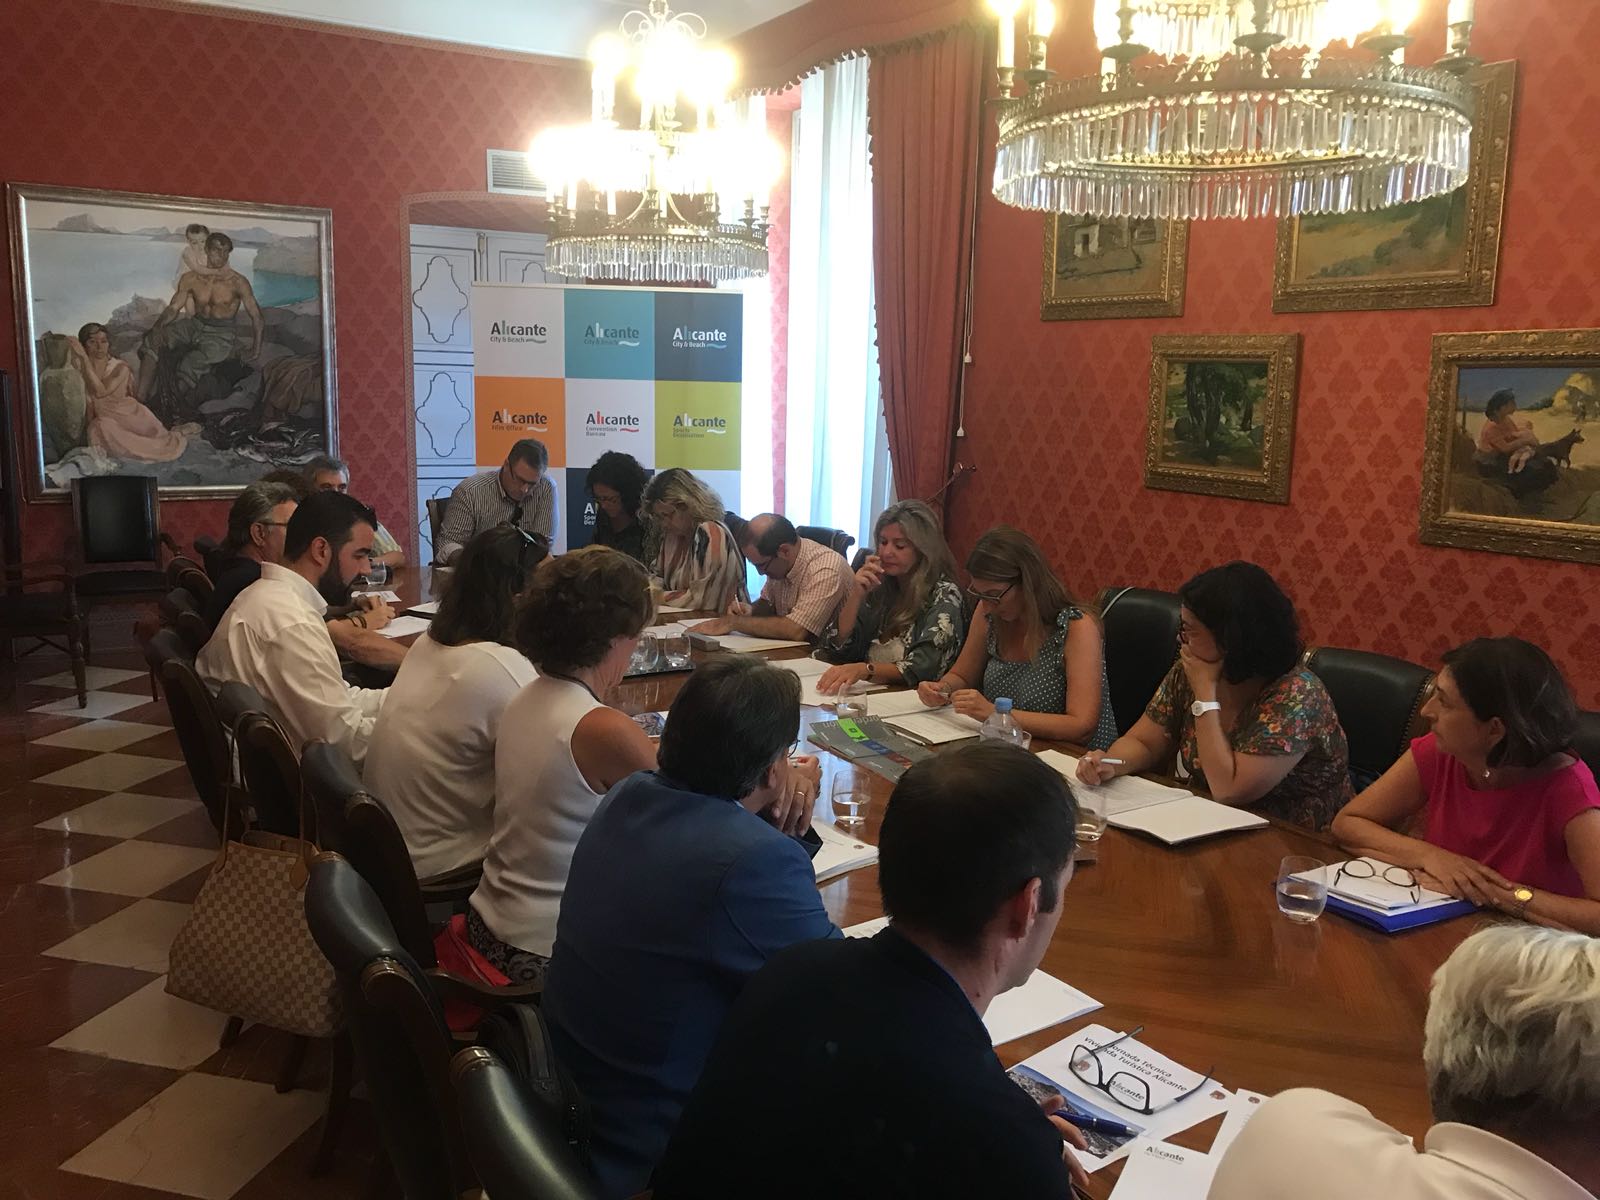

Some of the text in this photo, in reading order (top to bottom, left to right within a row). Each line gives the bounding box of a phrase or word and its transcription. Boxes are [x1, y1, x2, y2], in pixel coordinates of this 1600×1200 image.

[490, 320, 547, 336] Alicante
[584, 322, 640, 339] Alicante
[673, 325, 727, 341] Alicante
[492, 408, 548, 425] Alicante
[586, 411, 640, 426] Alicante
[673, 413, 727, 428] Alicante
[1152, 1073, 1188, 1092] Alicante
[1145, 1146, 1185, 1161] Alicante
